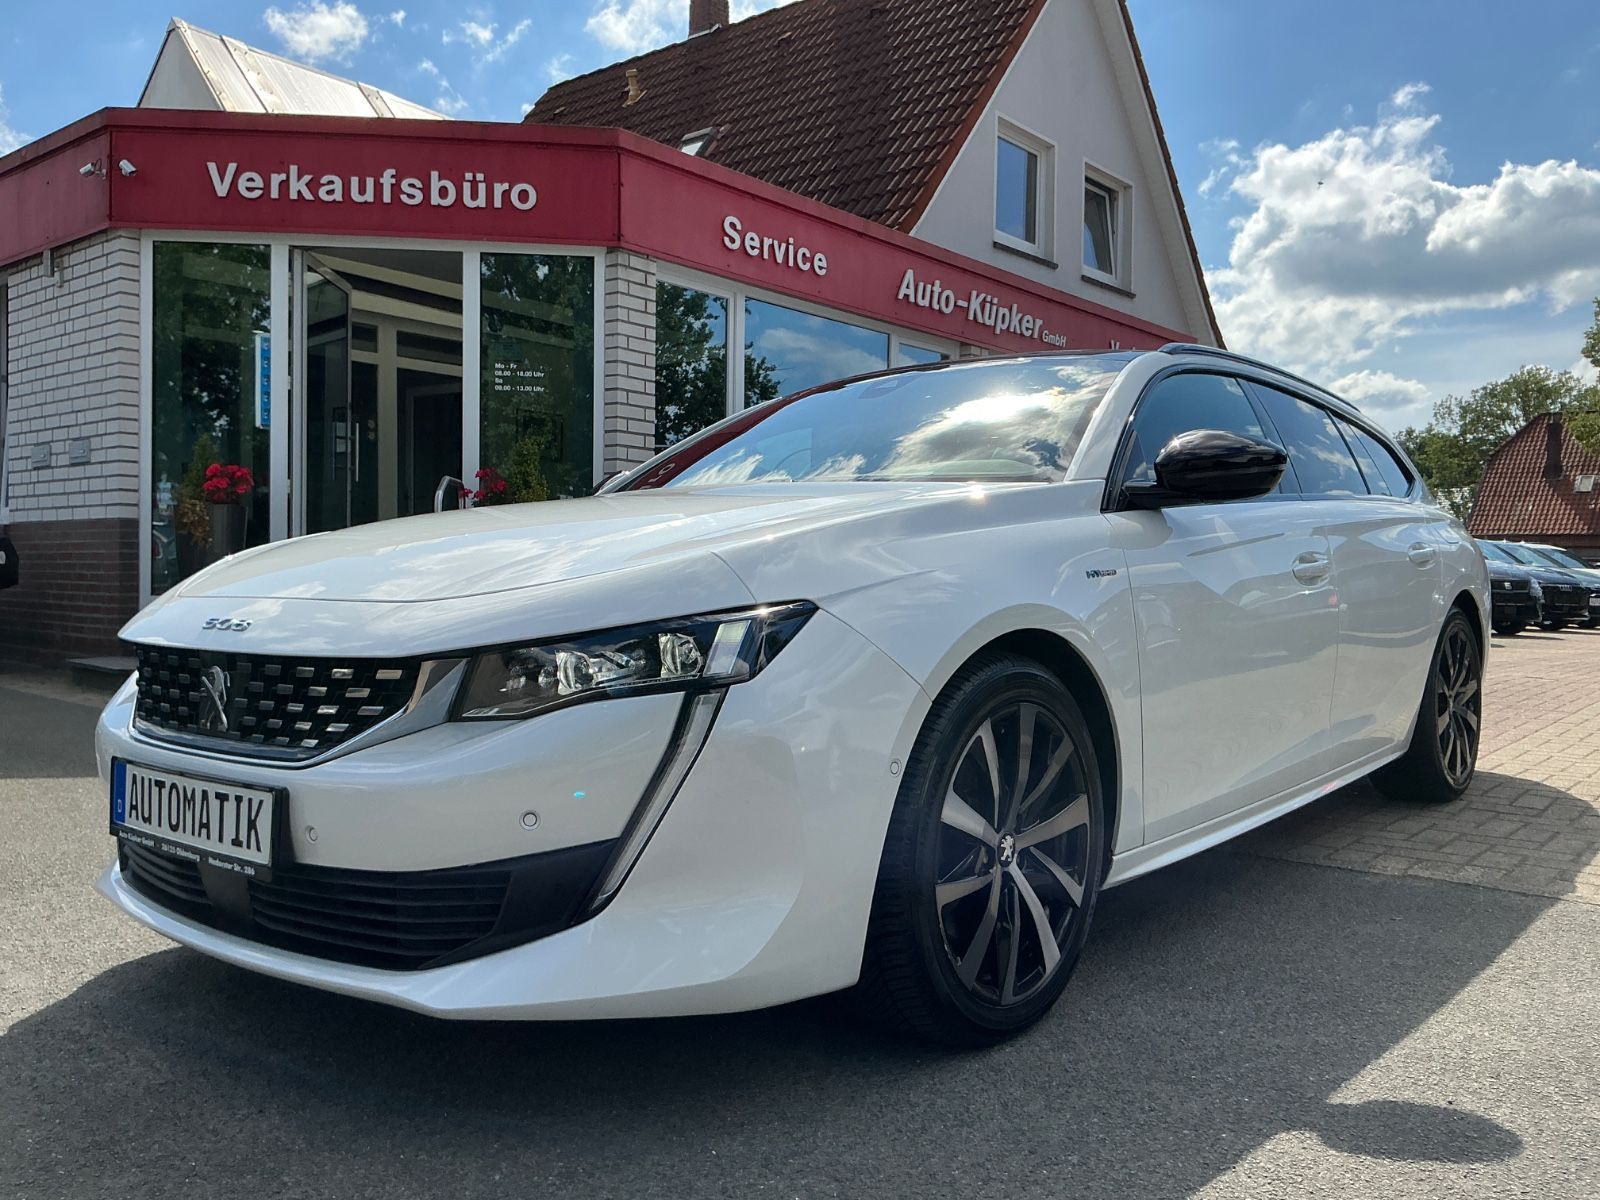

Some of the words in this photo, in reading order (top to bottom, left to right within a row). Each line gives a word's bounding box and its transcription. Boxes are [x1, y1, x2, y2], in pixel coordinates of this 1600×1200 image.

[206, 161, 538, 210] Verkaufsbüro
[722, 215, 828, 276] Service
[897, 268, 1043, 339] Auto-Küpker
[1042, 330, 1067, 348] GmbH
[117, 800, 123, 812] D
[128, 772, 265, 853] AUTOMATIK
